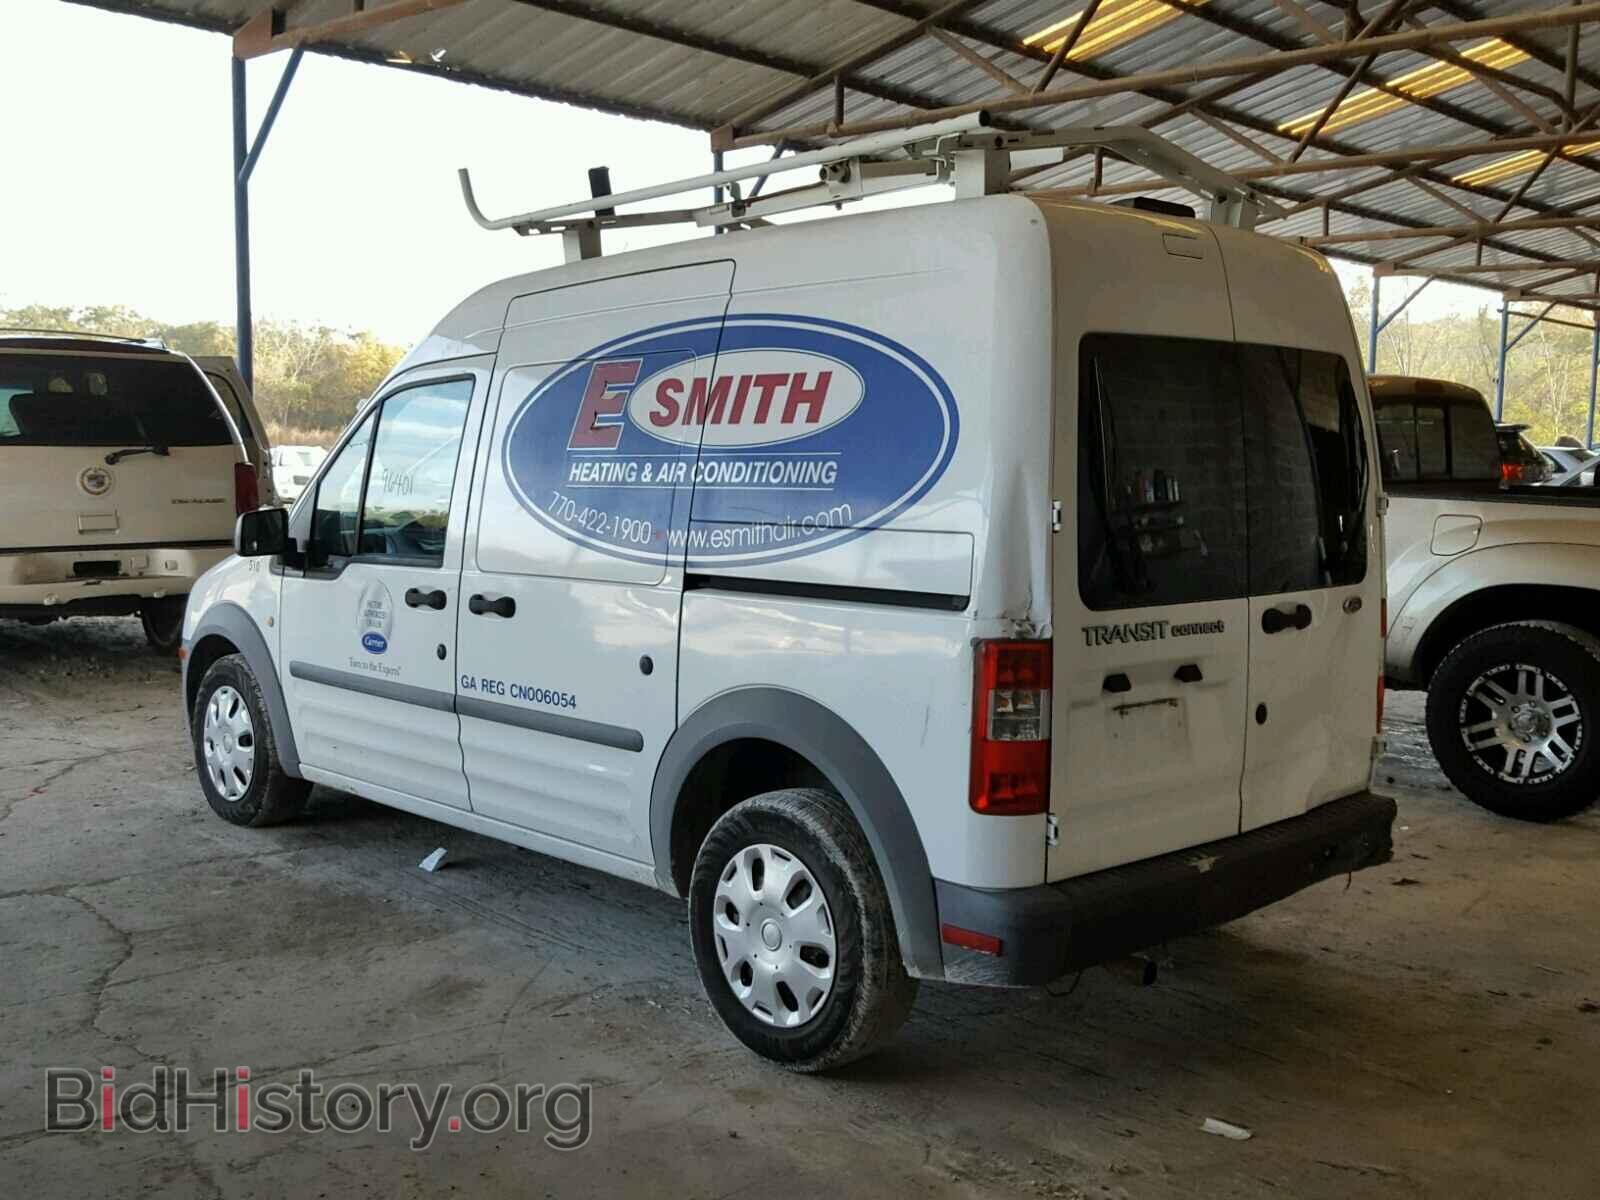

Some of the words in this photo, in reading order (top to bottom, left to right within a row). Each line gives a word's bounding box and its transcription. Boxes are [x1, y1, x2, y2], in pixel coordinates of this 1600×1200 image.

[566, 358, 644, 451] E
[649, 370, 833, 427] SMITH
[569, 462, 637, 482] HEATING
[641, 464, 653, 482] &
[656, 463, 686, 482] AIR
[691, 461, 838, 484] CONDITIONING
[548, 491, 652, 544] 770-422-1900
[666, 503, 852, 549] www.esmithair.com
[1082, 620, 1169, 646] TRANSIT
[1171, 619, 1224, 637] connect
[461, 674, 477, 691] GA
[481, 678, 505, 696] REG
[510, 683, 576, 709] CN006054
